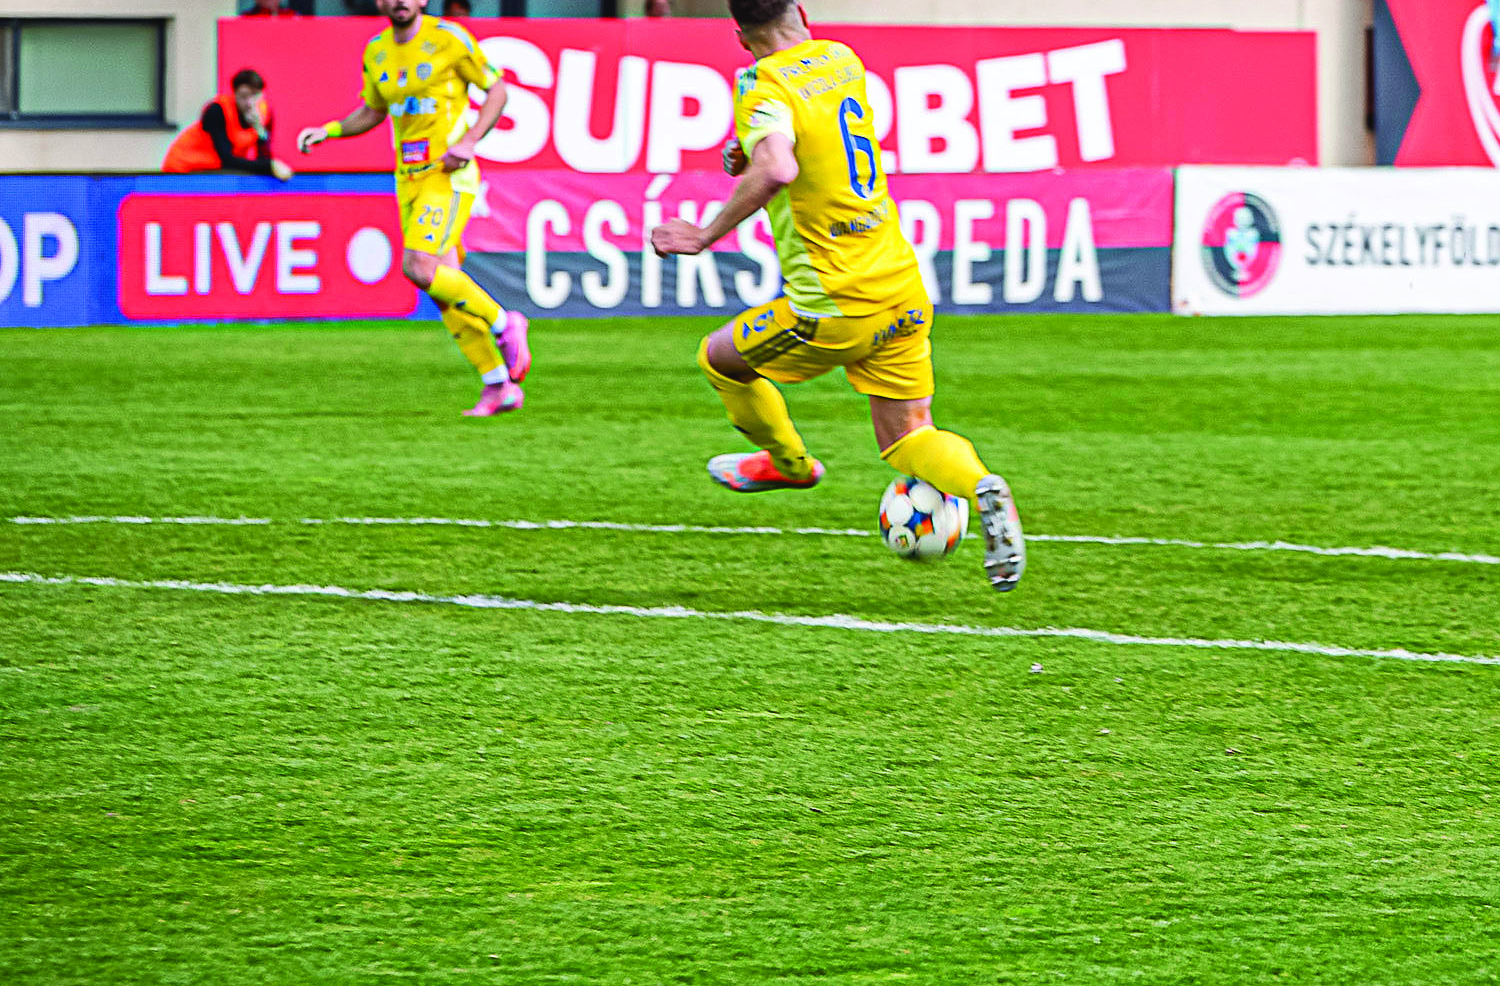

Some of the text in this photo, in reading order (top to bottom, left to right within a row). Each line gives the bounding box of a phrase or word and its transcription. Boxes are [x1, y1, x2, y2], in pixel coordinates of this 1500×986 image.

[468, 36, 1126, 175] SUPBET
[838, 96, 877, 200] 6
[144, 222, 323, 297] LIVE
[417, 205, 445, 227] 20
